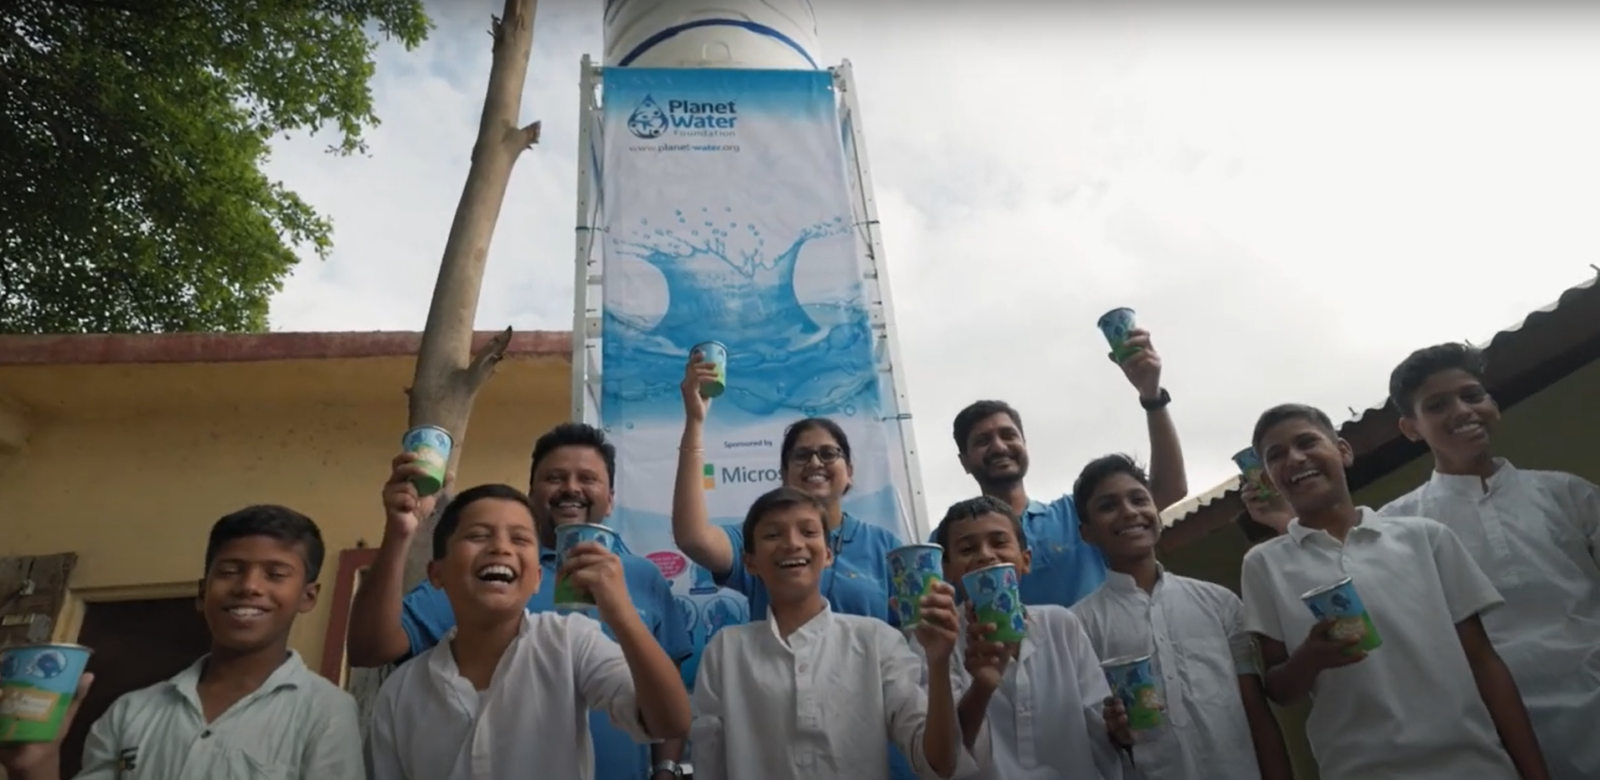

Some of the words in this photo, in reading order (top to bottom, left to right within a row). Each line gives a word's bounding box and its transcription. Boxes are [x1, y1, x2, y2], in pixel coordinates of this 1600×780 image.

[668, 99, 737, 114] Planet
[670, 114, 737, 129] Water
[673, 129, 736, 138] Foundation
[628, 143, 740, 153] www.planet-water.org
[724, 440, 763, 449] Sponsored
[764, 439, 773, 447] by
